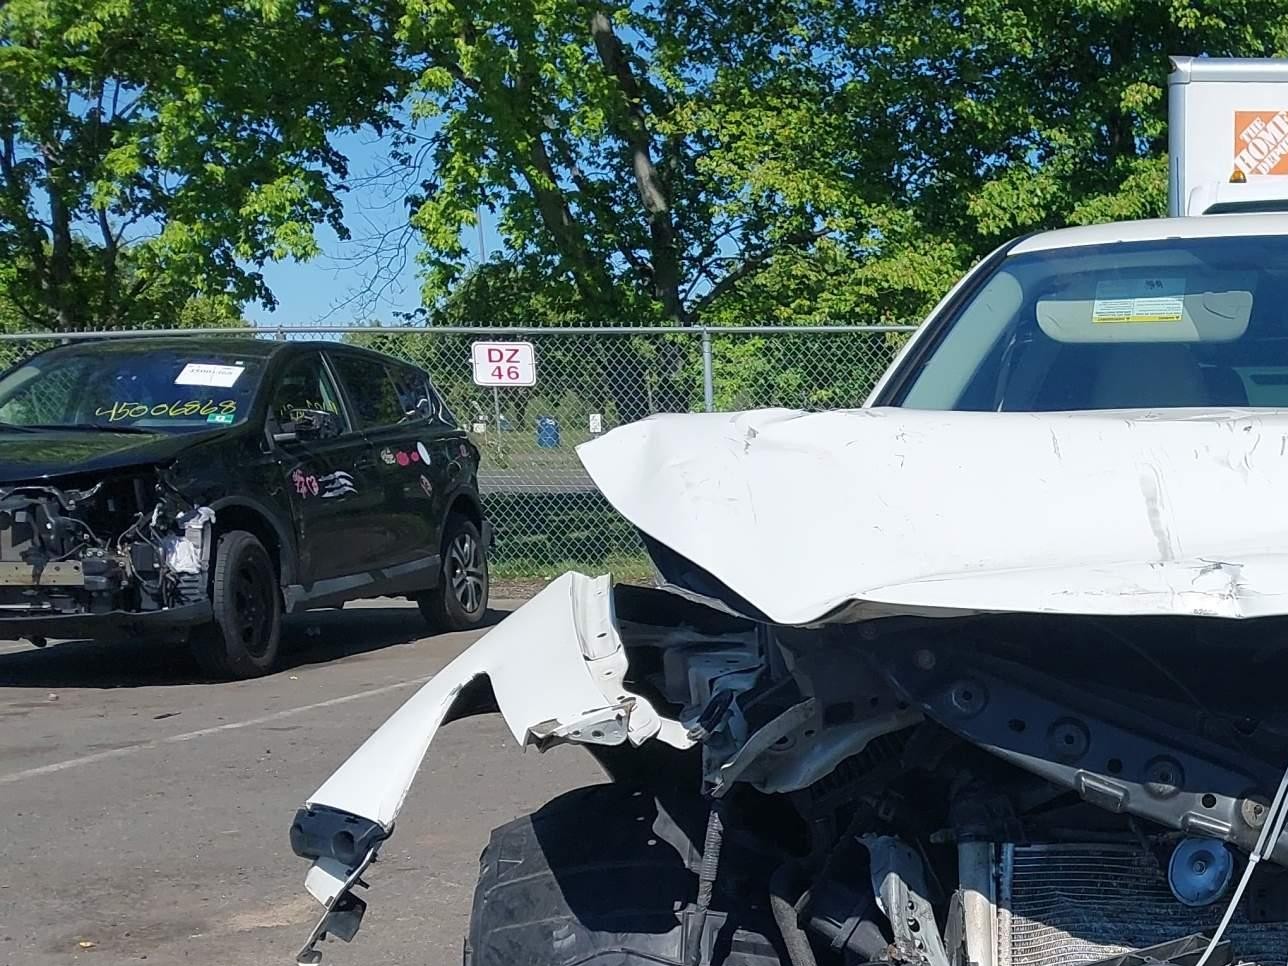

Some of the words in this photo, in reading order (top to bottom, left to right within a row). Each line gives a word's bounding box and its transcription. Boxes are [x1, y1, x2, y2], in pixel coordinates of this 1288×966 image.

[1239, 116, 1266, 143] THE
[487, 348, 521, 363] DZ
[491, 366, 520, 380] 46
[95, 399, 237, 422] 45006868
